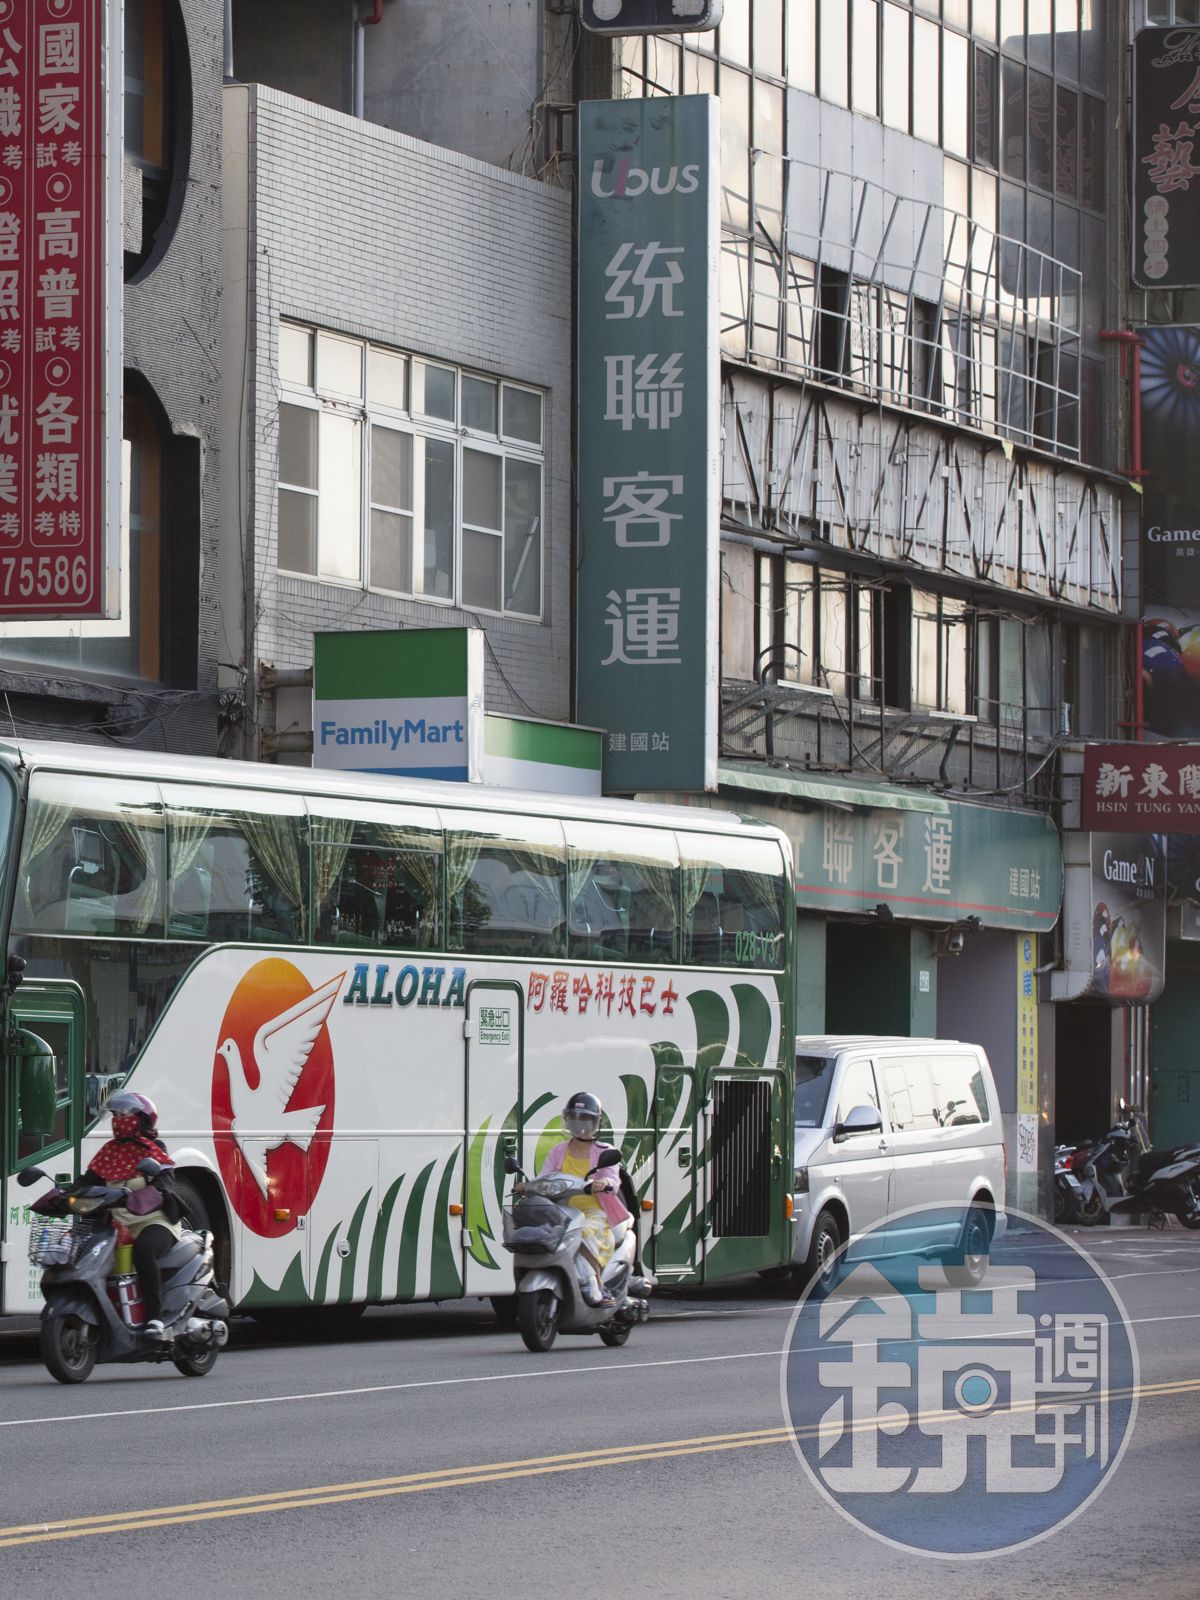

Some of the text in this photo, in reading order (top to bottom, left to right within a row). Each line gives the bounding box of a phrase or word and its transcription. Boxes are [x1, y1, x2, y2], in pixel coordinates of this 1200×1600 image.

[601, 241, 684, 666] 統聯客運
[320, 718, 464, 751] FamilyMart
[609, 731, 670, 752] 建國站
[1096, 801, 1128, 813] HSIN
[1135, 802, 1172, 813] TUNG
[735, 930, 777, 965] 028-V3
[343, 962, 467, 1008] ALOHA
[527, 970, 679, 1017] 阿羅哈科技巴士
[480, 1009, 510, 1028] 緊急出口
